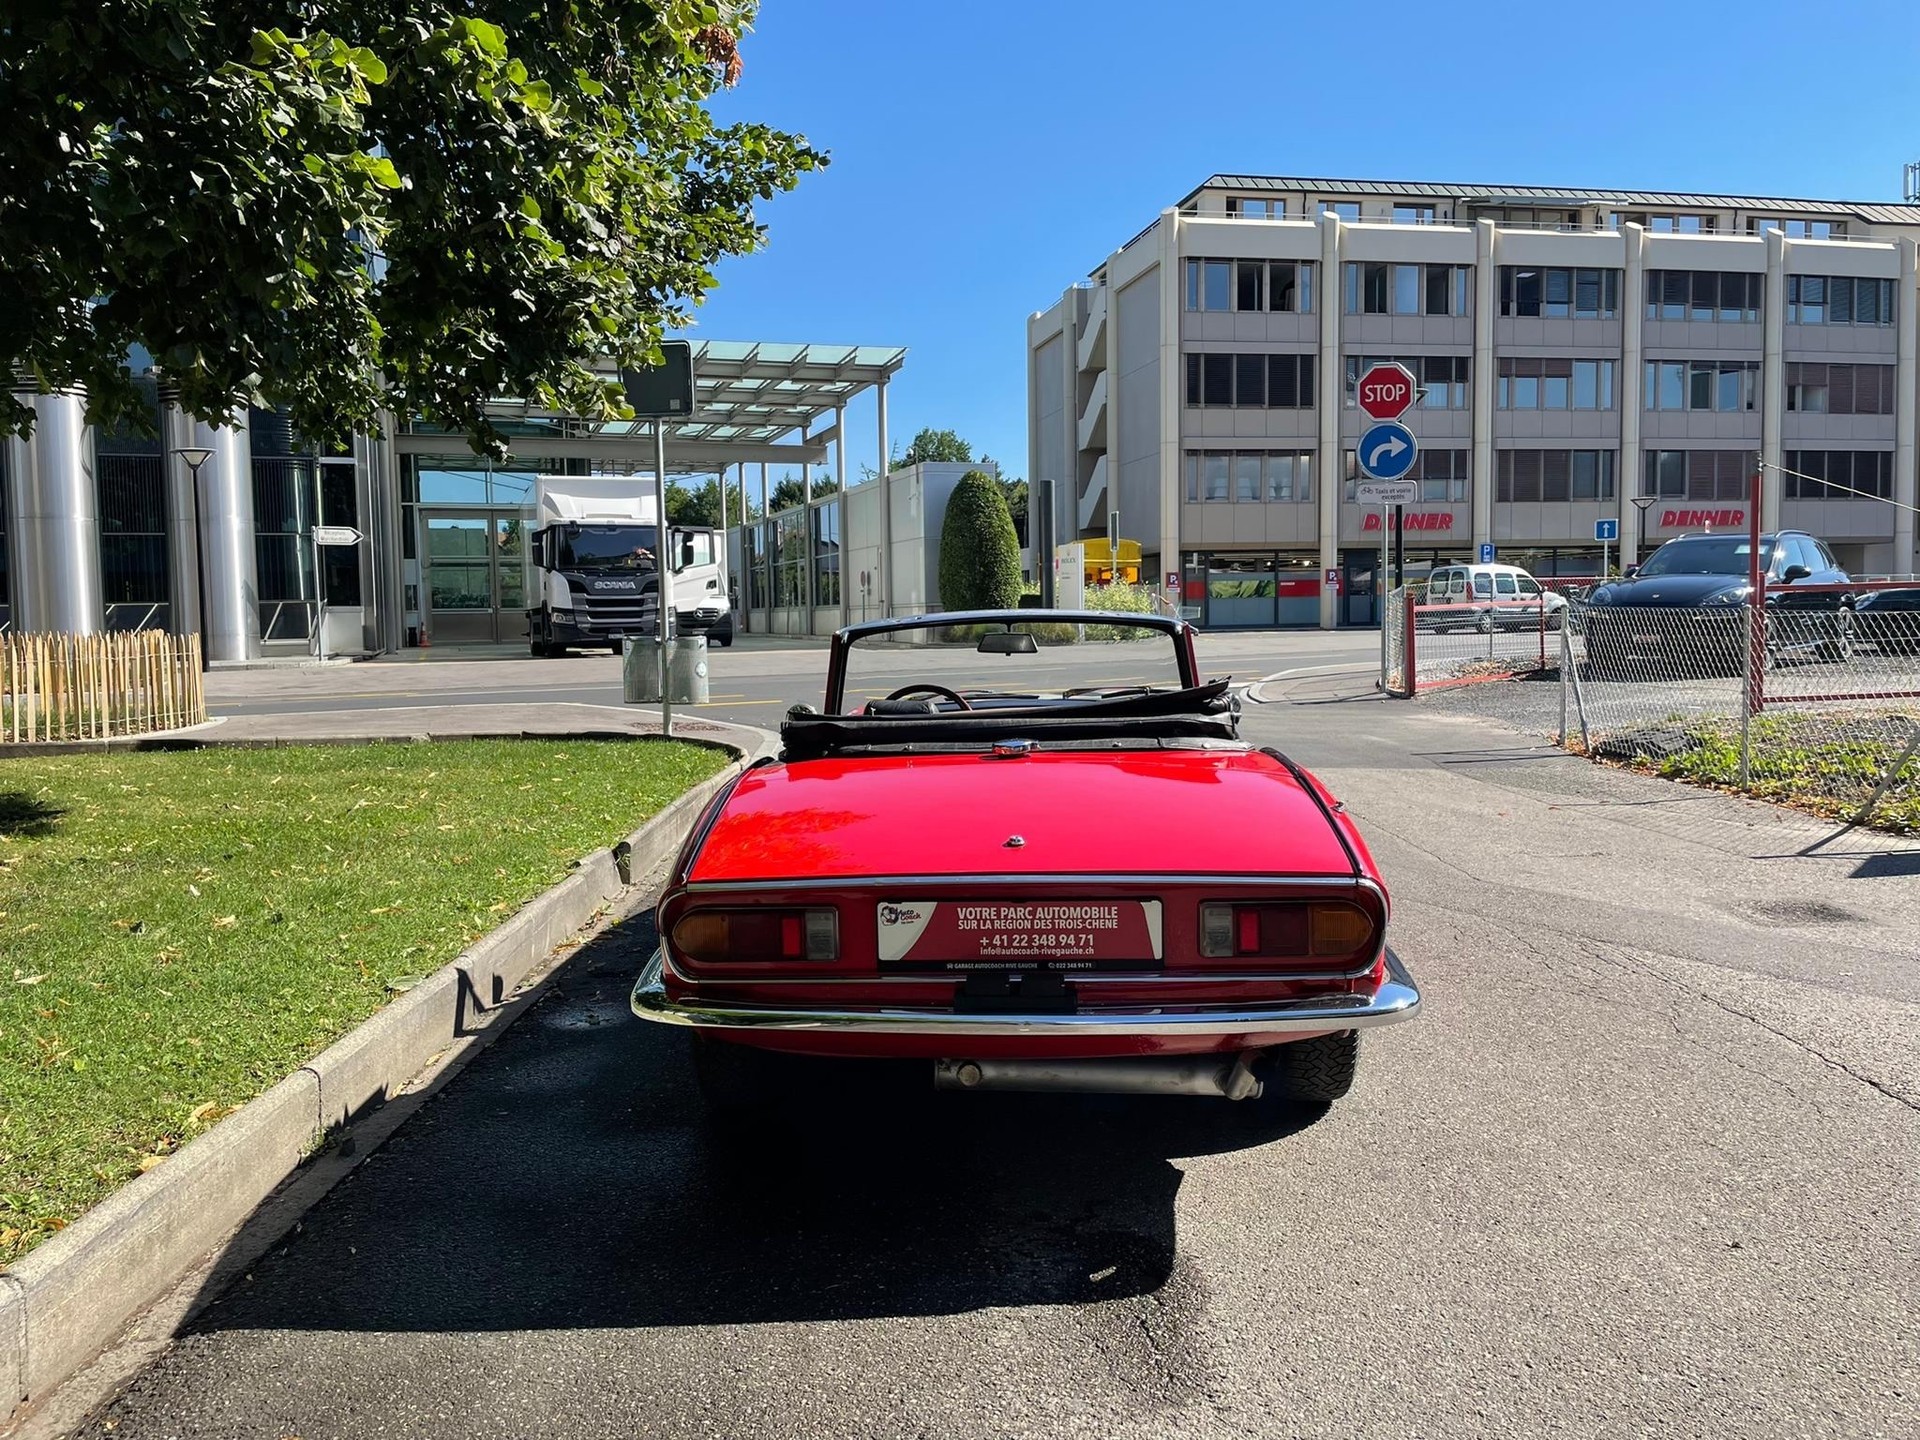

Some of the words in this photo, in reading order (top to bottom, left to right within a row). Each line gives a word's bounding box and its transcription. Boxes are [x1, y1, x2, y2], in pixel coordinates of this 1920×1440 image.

[1365, 384, 1405, 402] STOP
[1660, 510, 1745, 527] DENNER
[594, 581, 636, 590] SCANIA
[957, 907, 997, 920] VOTRE
[1000, 907, 1033, 919] PARC
[1035, 906, 1118, 919] AUTOMOBILE
[958, 919, 978, 930] SUR
[980, 919, 992, 930] LA
[994, 919, 1031, 930] REGION
[1034, 919, 1052, 929] DES
[1054, 919, 1118, 929] TROIS-CHENE
[980, 936, 990, 946] +
[992, 934, 1008, 947] 41
[1012, 934, 1028, 947] 22
[1031, 934, 1056, 946] 348
[1059, 934, 1075, 946] 94
[1078, 934, 1094, 946] 71
